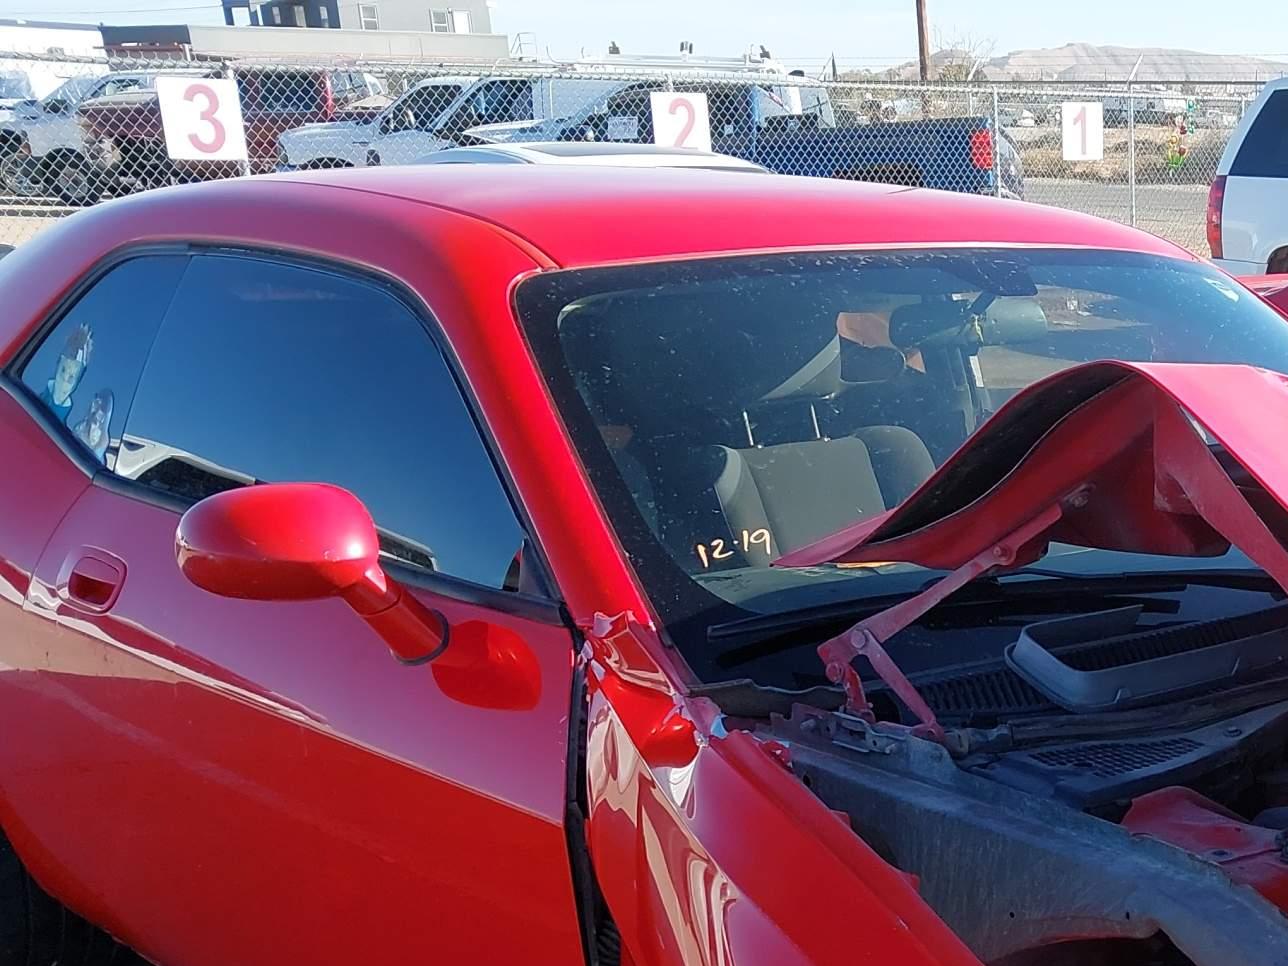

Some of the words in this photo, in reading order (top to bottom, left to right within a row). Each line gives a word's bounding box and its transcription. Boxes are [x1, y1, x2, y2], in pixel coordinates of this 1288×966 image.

[182, 83, 226, 154] 3
[668, 97, 698, 150] 2
[1072, 106, 1088, 156] 1
